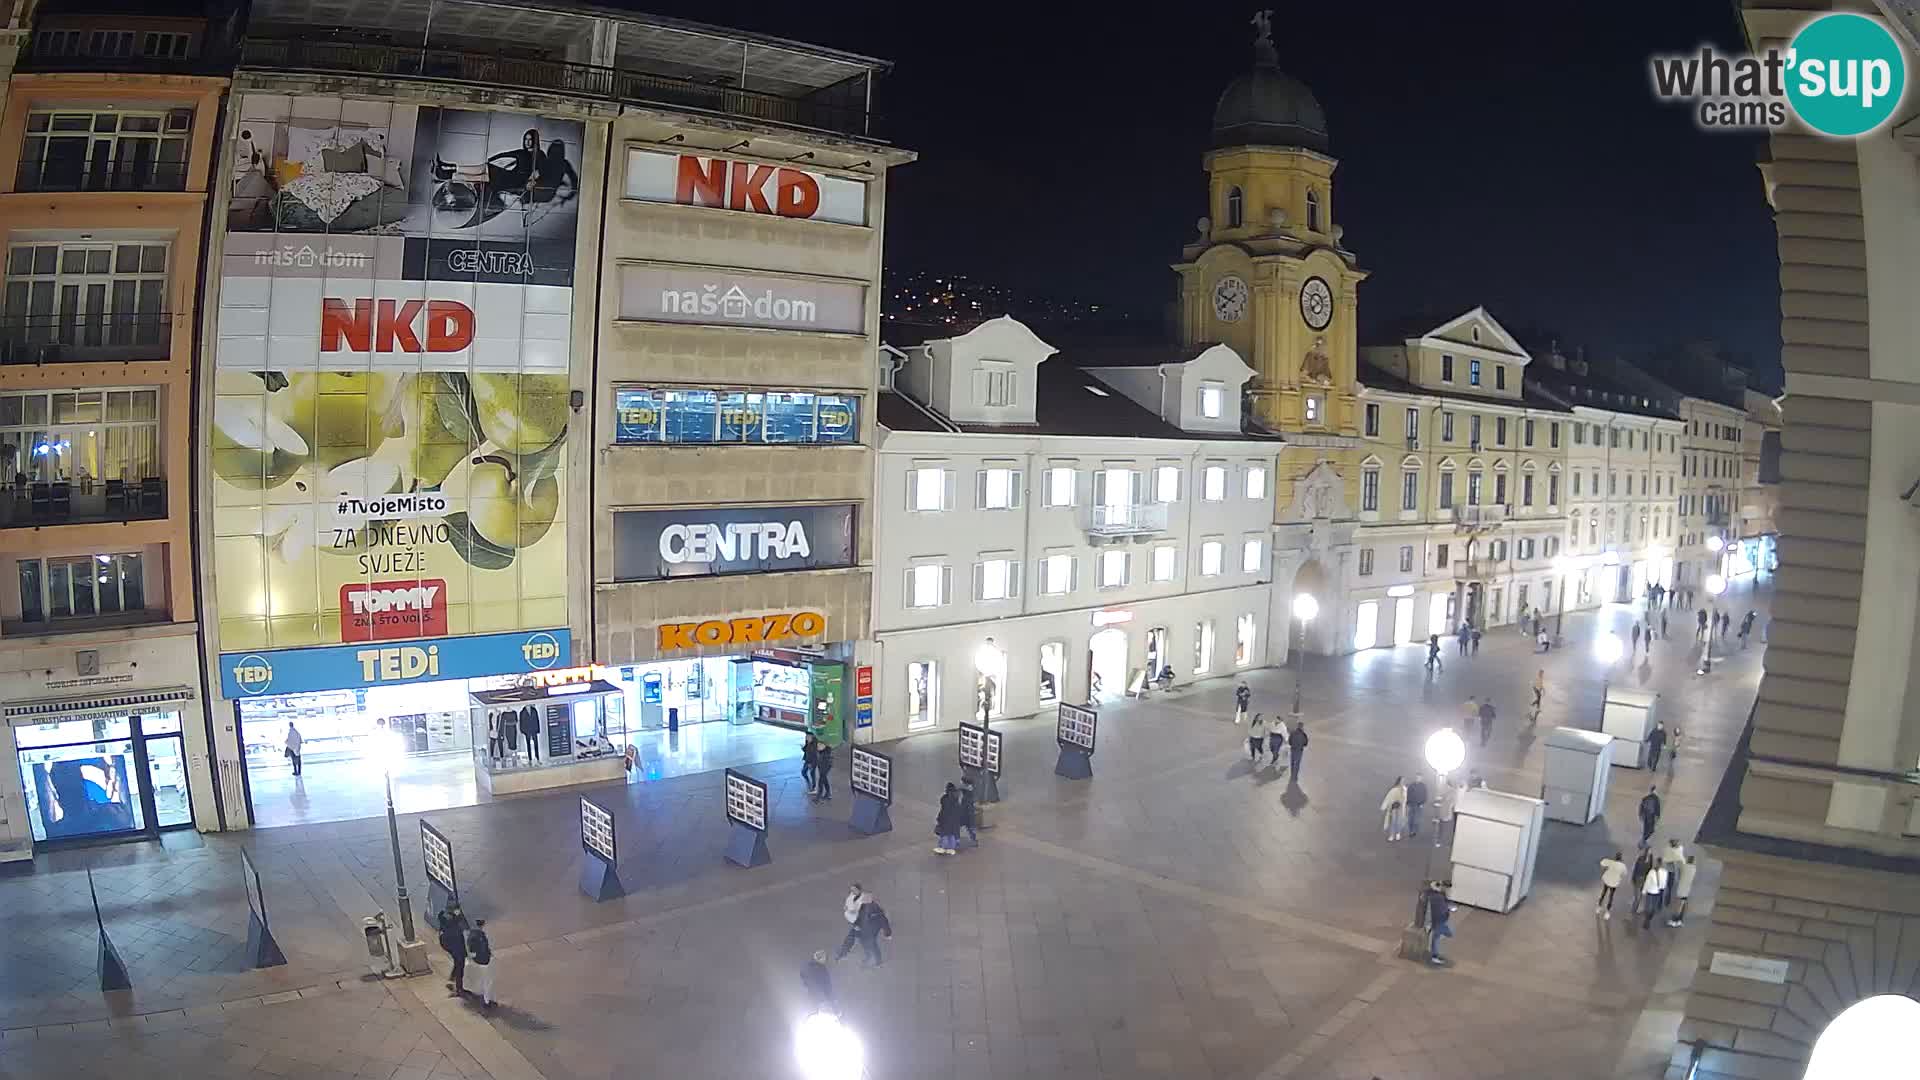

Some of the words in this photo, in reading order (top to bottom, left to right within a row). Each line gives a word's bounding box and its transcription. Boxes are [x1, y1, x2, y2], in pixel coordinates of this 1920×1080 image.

[676, 155, 820, 219] NKD
[255, 246, 293, 267] naš
[319, 245, 366, 269] dom
[447, 249, 535, 277] CENTRA
[661, 284, 718, 317] naš
[754, 289, 816, 323] dom
[320, 296, 477, 354] NKD
[338, 496, 446, 516] #TvojeMisto
[333, 528, 357, 549] ZA
[368, 523, 450, 547] DNEVNO
[658, 520, 812, 564] CENTRA
[359, 547, 426, 575] SVJEŽE
[348, 586, 439, 615] TOMMY
[658, 611, 826, 651] KORZO
[357, 644, 440, 683] TEDi
[522, 643, 560, 660] TEDi
[233, 664, 274, 685] TEDi
